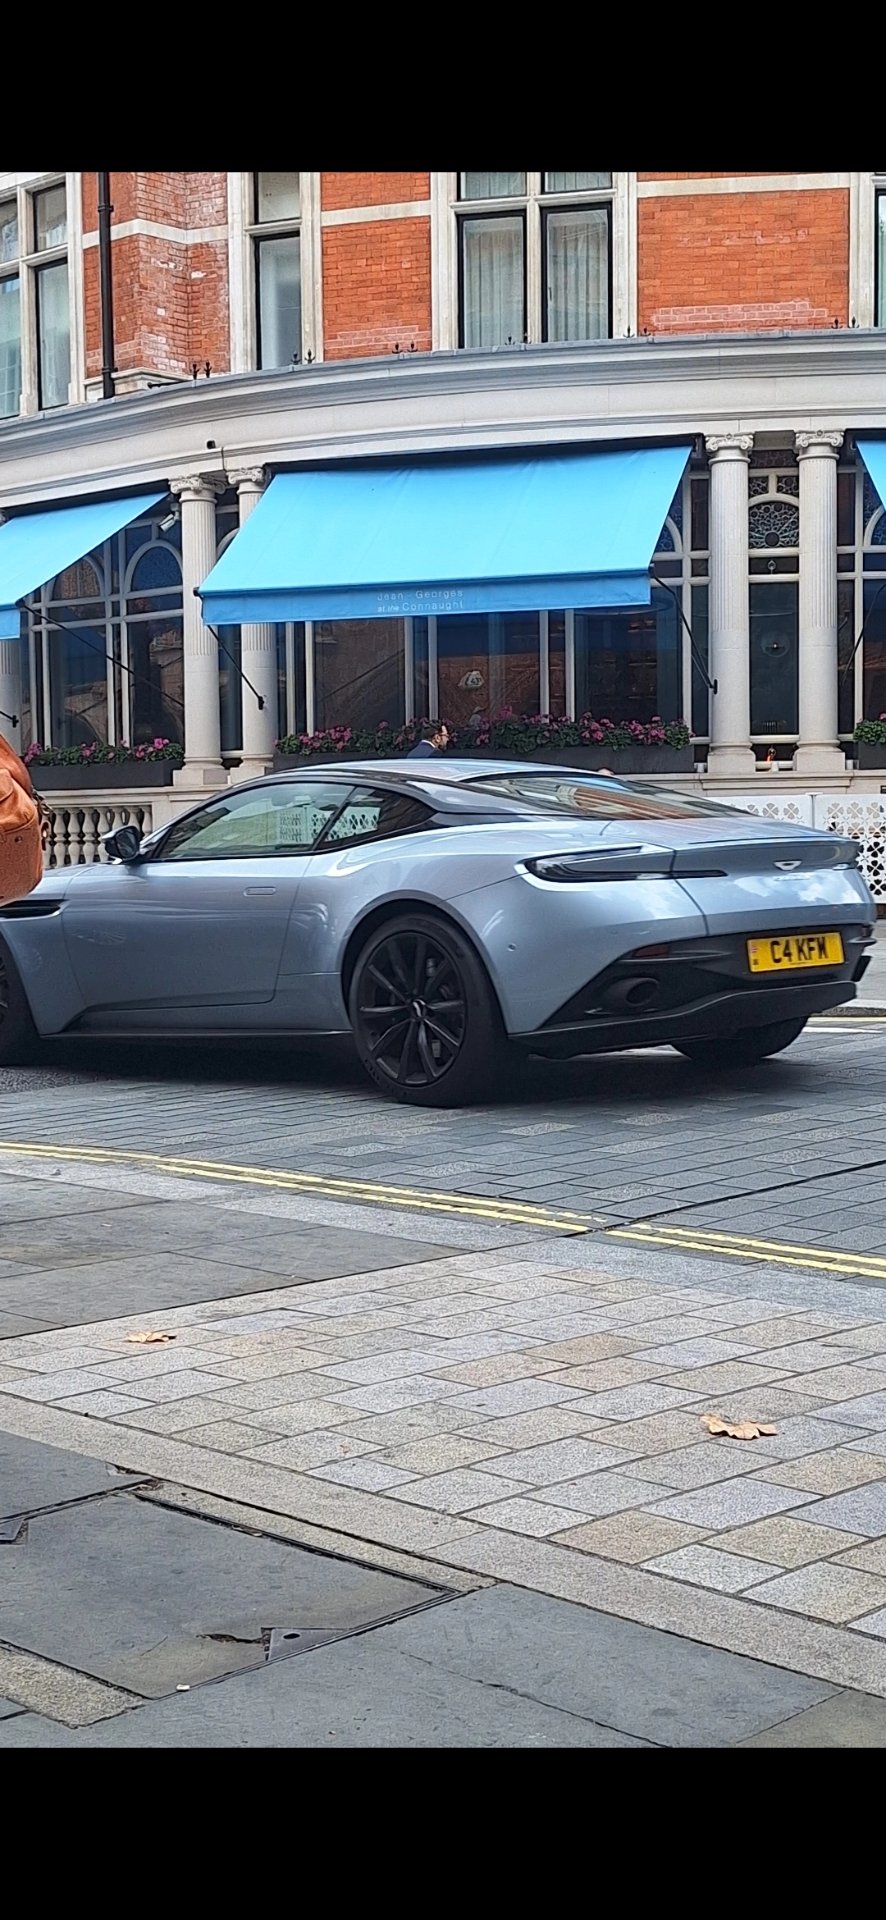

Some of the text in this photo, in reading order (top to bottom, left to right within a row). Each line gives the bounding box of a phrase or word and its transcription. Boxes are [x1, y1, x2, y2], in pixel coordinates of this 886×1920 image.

[377, 589, 464, 601] Jean Georges
[402, 601, 464, 611] Connaught
[770, 936, 829, 963] C4 KFW
